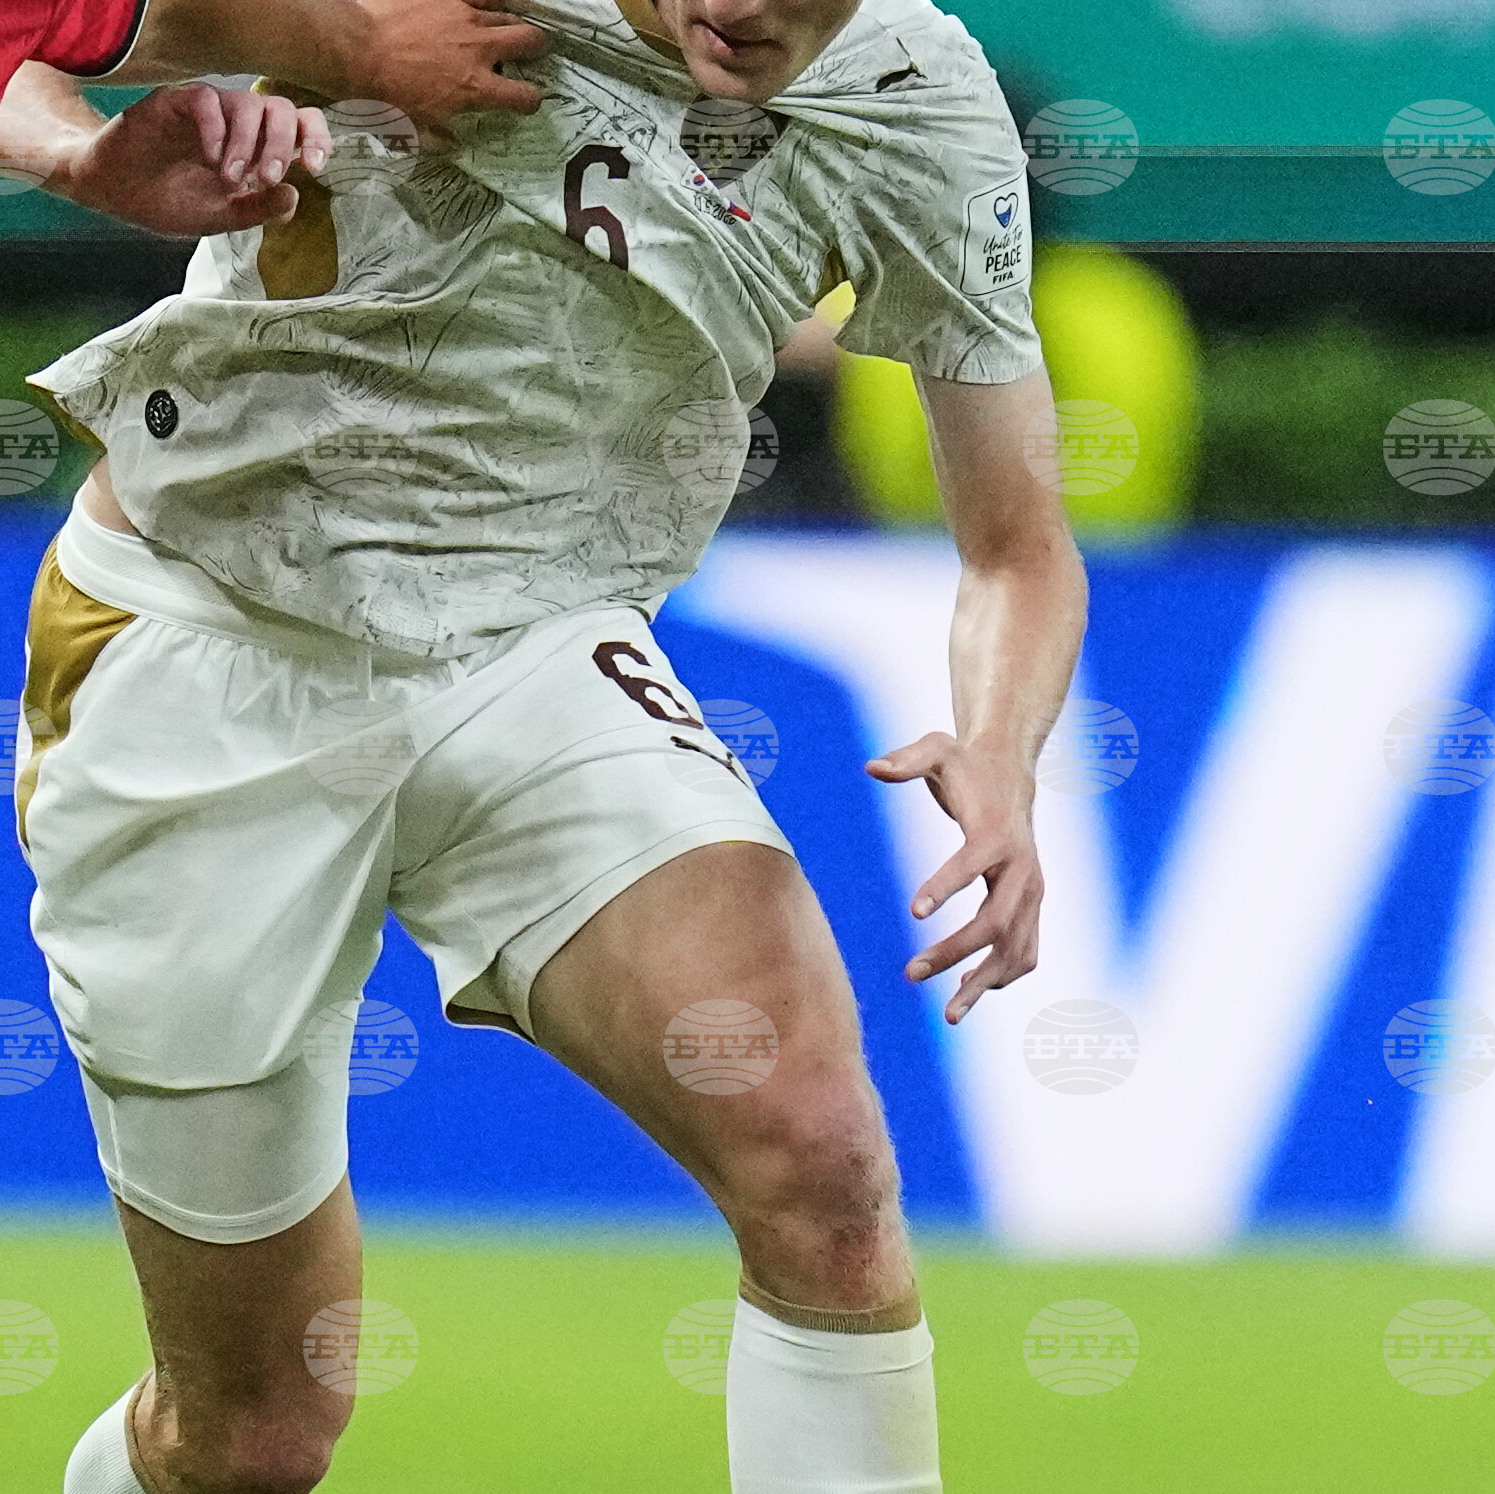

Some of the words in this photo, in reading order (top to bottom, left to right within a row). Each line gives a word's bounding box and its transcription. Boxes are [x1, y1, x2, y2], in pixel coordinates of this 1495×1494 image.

[563, 144, 631, 272] 6
[985, 244, 1022, 274] PEACE
[992, 271, 1014, 285] FIFA
[591, 641, 704, 730] 6
